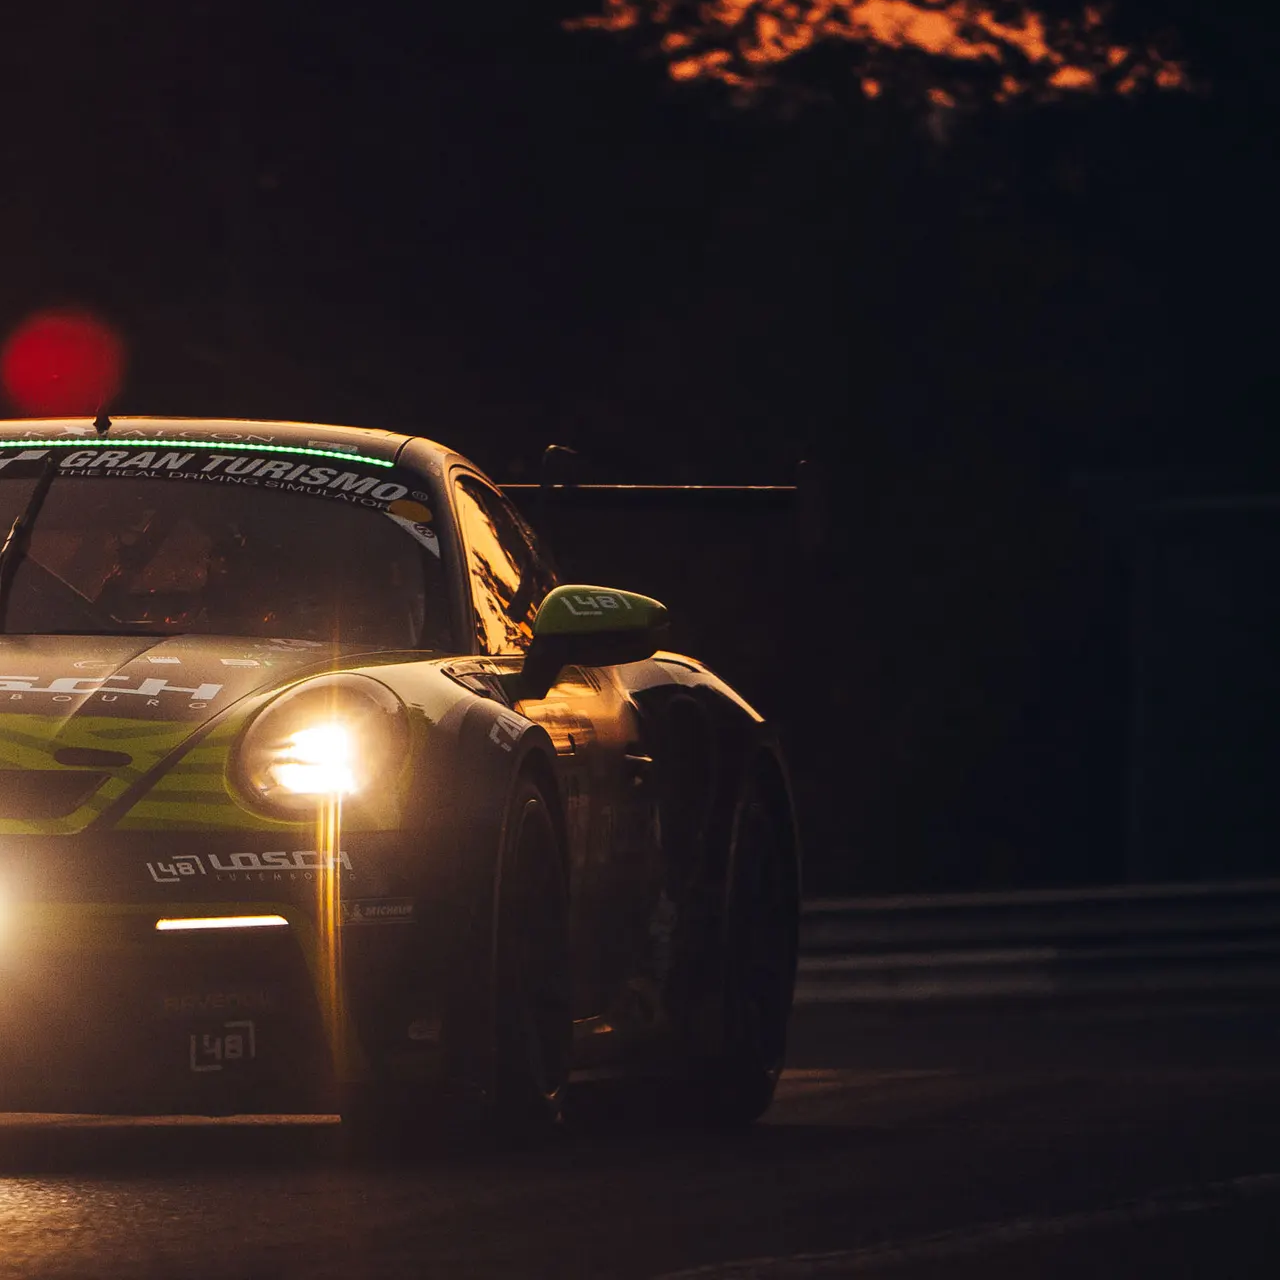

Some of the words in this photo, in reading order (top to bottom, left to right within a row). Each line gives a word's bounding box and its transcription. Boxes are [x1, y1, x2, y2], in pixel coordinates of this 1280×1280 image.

[59, 449, 197, 470] GRAN
[200, 453, 409, 502] TURISMO
[106, 469, 162, 478] REAL
[172, 470, 258, 486] DRIVING
[264, 480, 391, 513] SIMULATOR
[207, 850, 353, 871] LOSCH
[216, 872, 357, 881] LUXEMBOG
